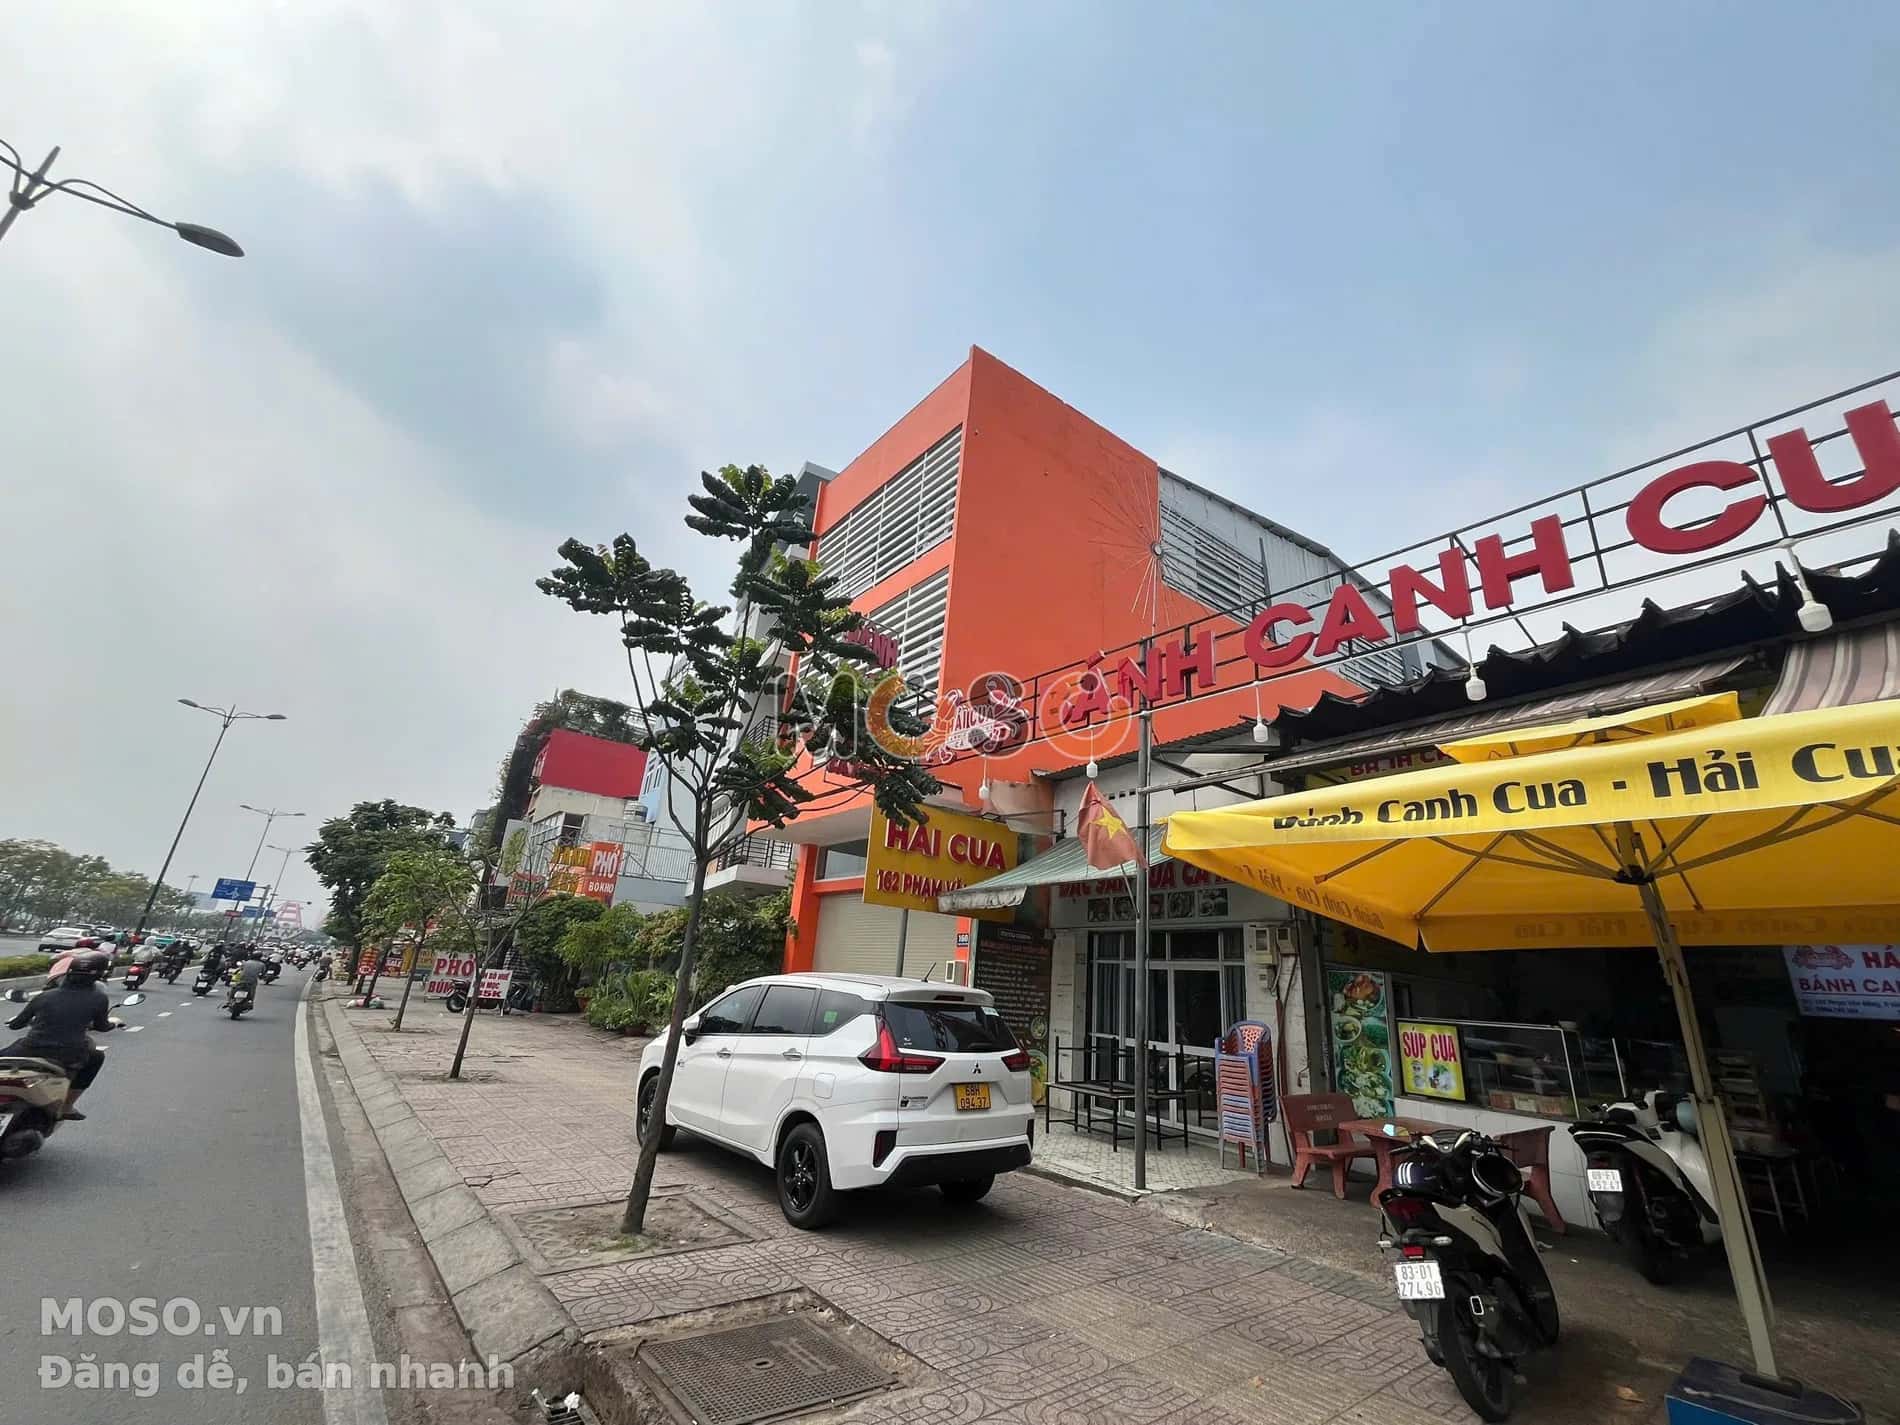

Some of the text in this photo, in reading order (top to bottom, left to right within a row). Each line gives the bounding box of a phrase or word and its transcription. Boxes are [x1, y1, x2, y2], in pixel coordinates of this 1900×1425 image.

[1243, 513, 1576, 669] CANH
[1377, 789, 1478, 824] Canh
[1493, 779, 1588, 814] Cua
[1647, 750, 1760, 798] Hải
[1791, 743, 1900, 783] Cu
[592, 844, 620, 879] PHỞ
[948, 833, 1007, 870] CUA
[433, 953, 477, 977] PHỞ
[1402, 1025, 1457, 1063] SÚP CUA
[1399, 1280, 1442, 1298] 274.96
